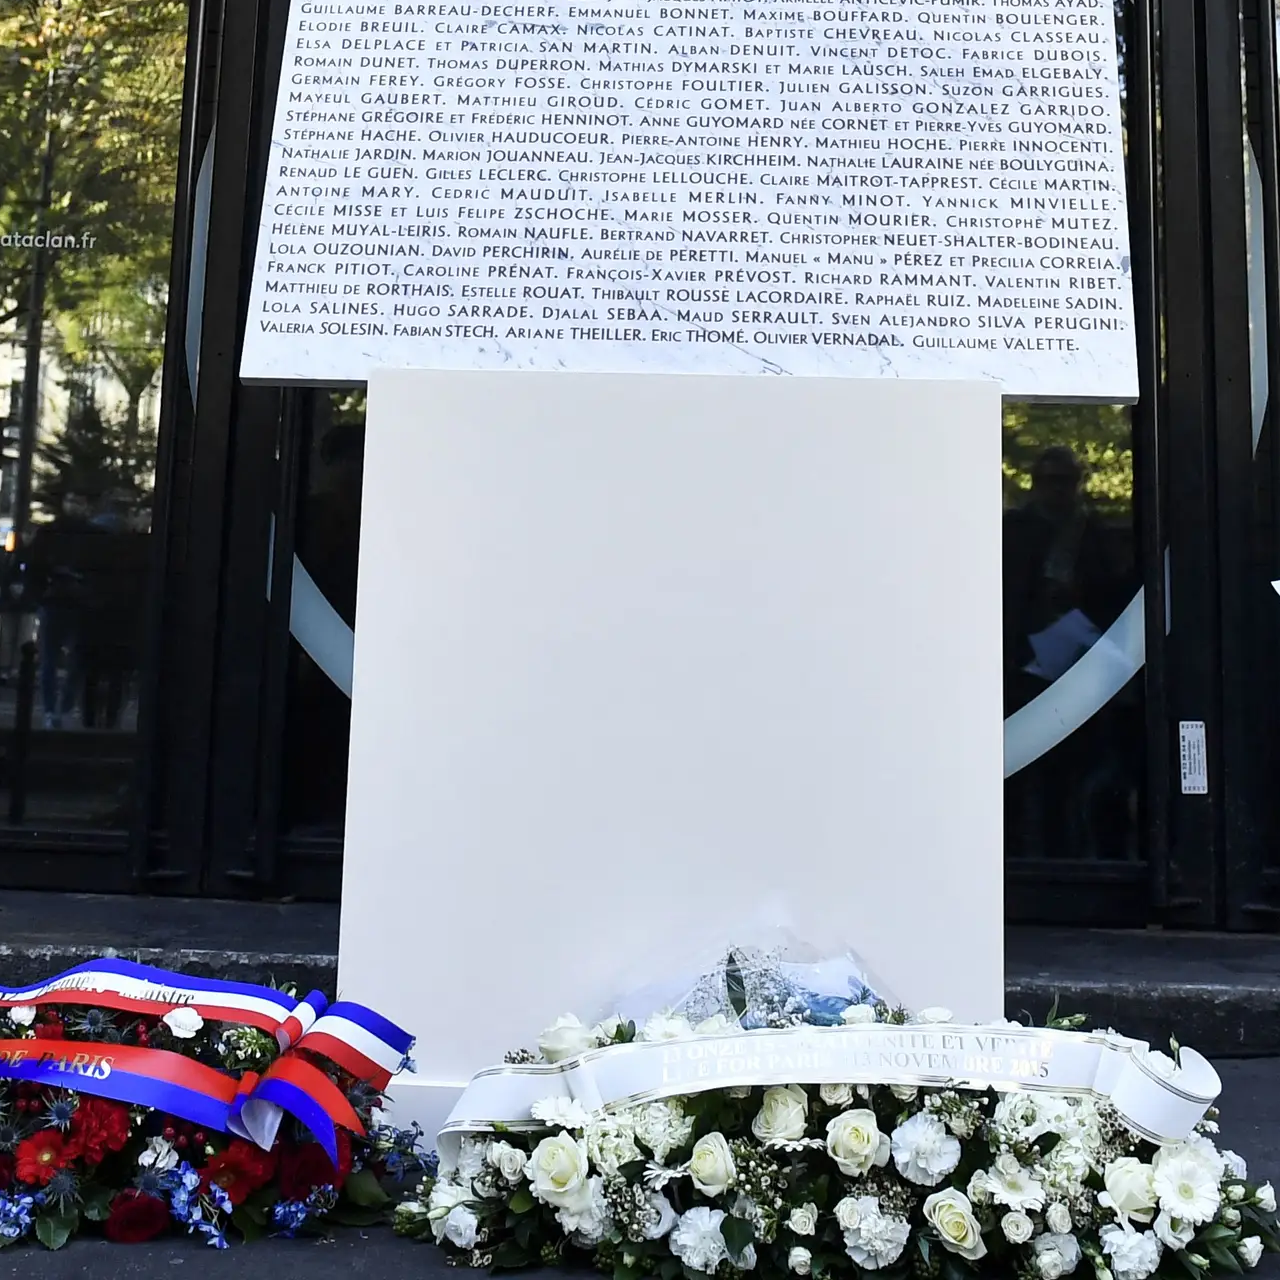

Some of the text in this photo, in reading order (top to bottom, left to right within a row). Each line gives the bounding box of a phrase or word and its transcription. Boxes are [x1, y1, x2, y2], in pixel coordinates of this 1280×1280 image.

[298, 20, 350, 32] ELODIE
[360, 20, 424, 33] BREUIL.
[434, 22, 488, 34] CLAIRE
[577, 23, 644, 36] NICOLAS
[653, 25, 734, 37] CATINAT.
[745, 27, 814, 38] BAPTISTE
[823, 27, 923, 40] CHEVREAU.
[933, 30, 1001, 42] NICOLAS
[1010, 31, 1106, 43] CLASSEAU.
[291, 74, 1108, 98] GERMAIN FEREY. GRÉGORY FOSSE. CHRISTOPHE FOULTIER. JULIEN GALISSON. SUZON GARRIGUES.
[284, 129, 1113, 153] STÉPHANE HACHE. OLIVIER HAUDUCOEUR. PIERRE-ANTOINE HENRY. MATHIEU HOCHE. PIERRE INNOCENTI.
[276, 185, 350, 197] ANTOINE
[361, 185, 419, 198] MARY.
[500, 187, 593, 201] MAUDUIT.
[604, 191, 676, 203] ISABELLE
[688, 191, 764, 204] MERLIN.
[776, 192, 833, 205] FANNY
[842, 193, 910, 207] MINOT.
[922, 197, 998, 208] YANNICK
[1010, 197, 1118, 211] MINVIELLE.
[331, 223, 450, 237] MUYAL-LEIRIS.
[457, 226, 517, 238] ROMAIN
[524, 226, 593, 240] NAUFLE.
[600, 228, 675, 241] BERTRAND
[681, 229, 773, 243] NAVARRET.
[779, 233, 877, 245] CHRISTOPHER
[883, 233, 1118, 250] NEUET-SHALTER-BODINEAU.
[267, 260, 1123, 290] FRANCK PITIOT. CAROLINE PRÉNAT. FRANÇOIS-XAVIER PRÉVOST. RICHARD RAMMANT. VALENTIN RIBET.
[942, 1034, 965, 1050] ET
[35, 1051, 117, 1080] PARIS
